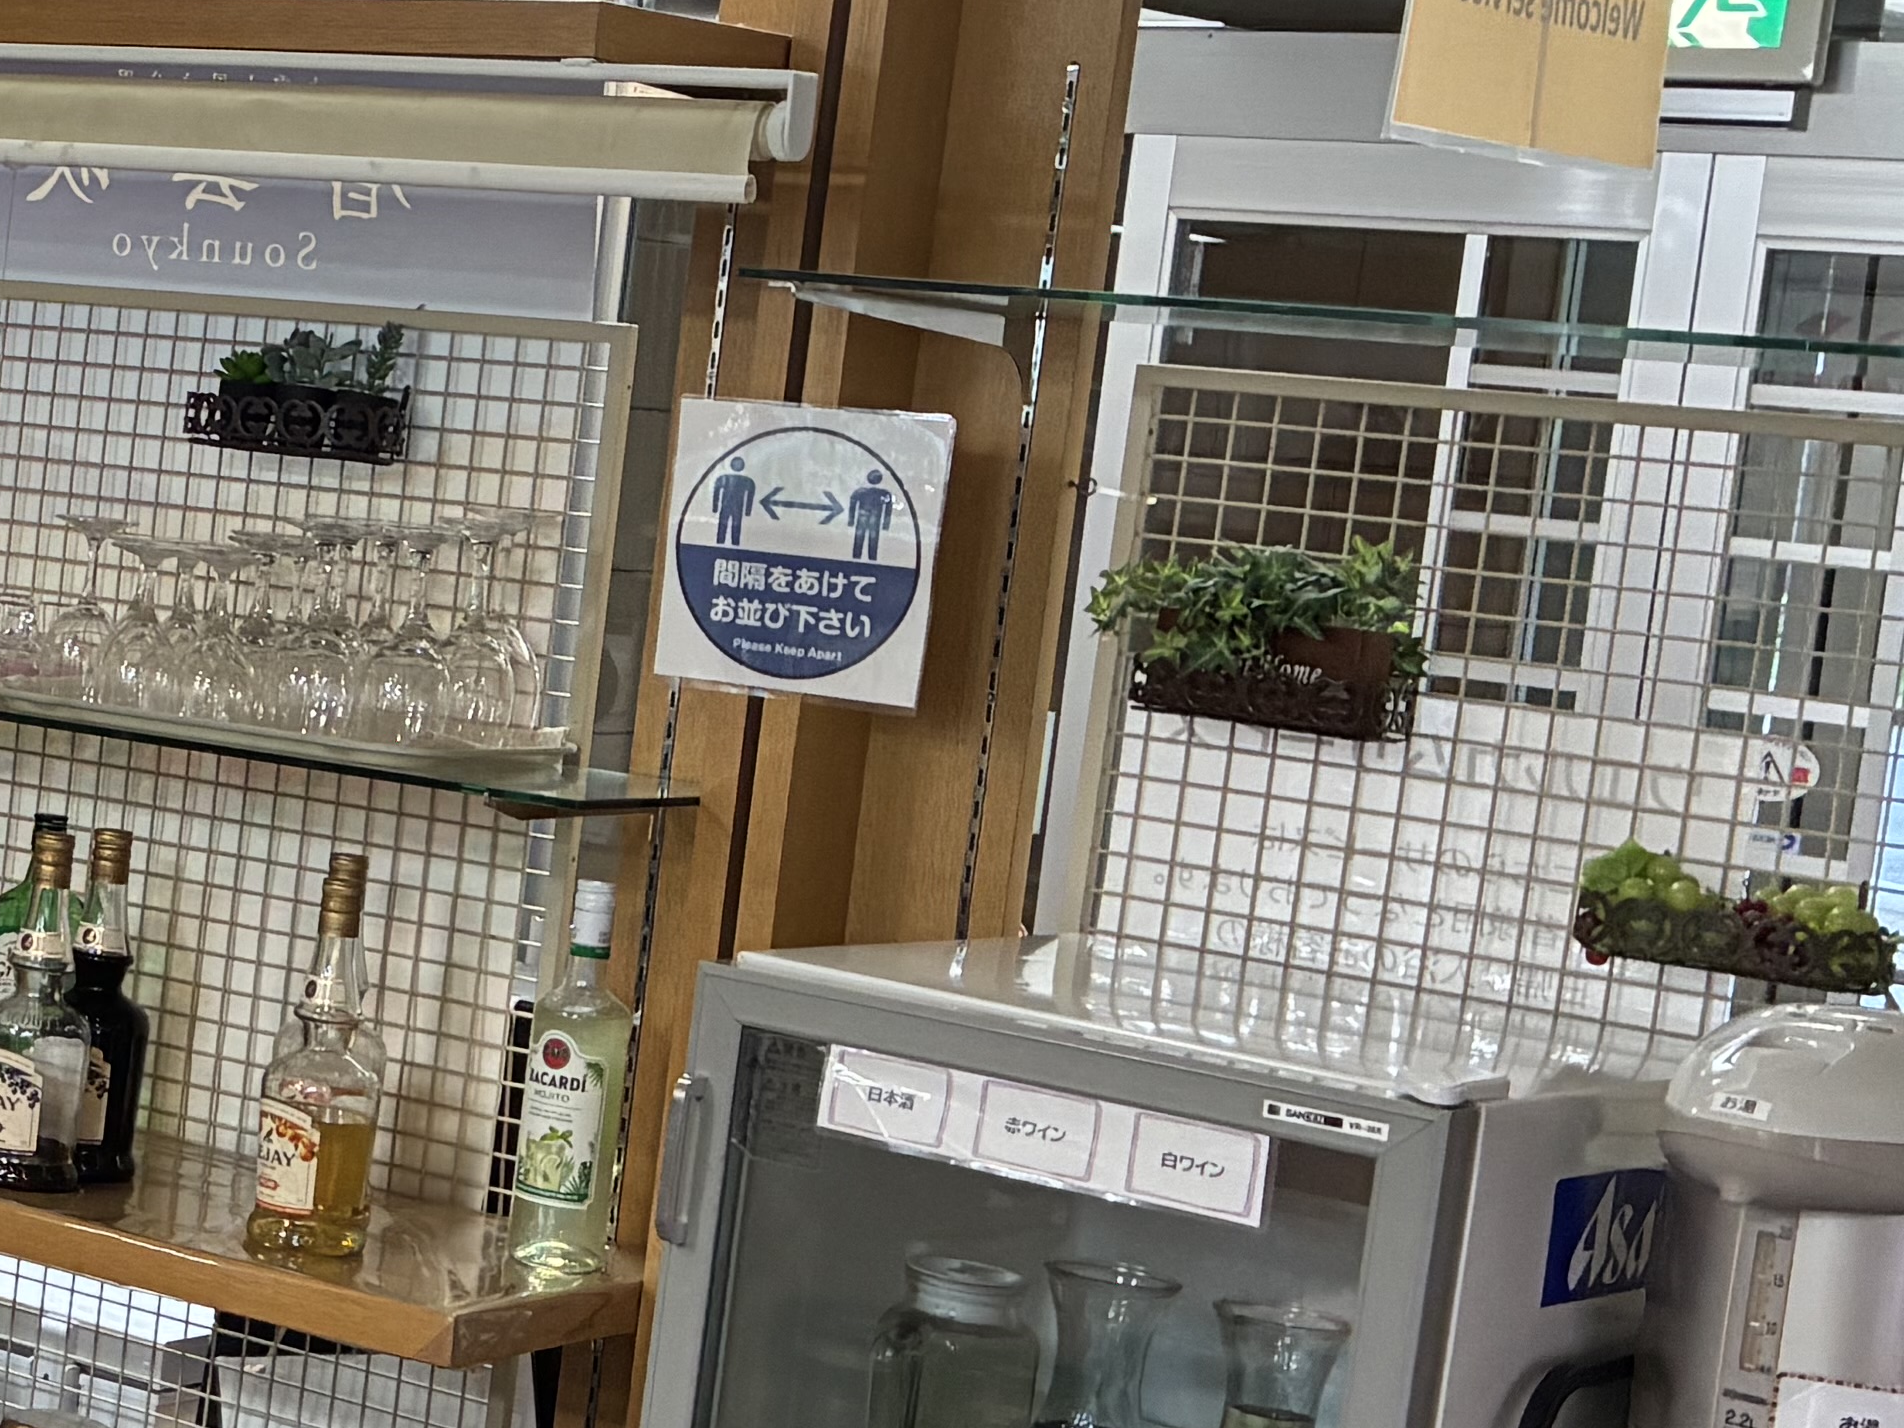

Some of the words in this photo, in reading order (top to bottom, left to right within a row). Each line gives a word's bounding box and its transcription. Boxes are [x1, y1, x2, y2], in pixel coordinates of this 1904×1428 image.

[711, 557, 878, 604] 間隔をあけて
[709, 595, 873, 639] お並び下さい
[732, 637, 772, 654] Please
[774, 640, 805, 658] Keep
[806, 645, 843, 663] Apart
[866, 1086, 915, 1112] 日本酒
[1004, 1116, 1068, 1144] 赤ワイン
[258, 1143, 296, 1167] EJAY
[1160, 1150, 1226, 1179] 白ワイン
[1568, 1174, 1665, 1292] Asa
